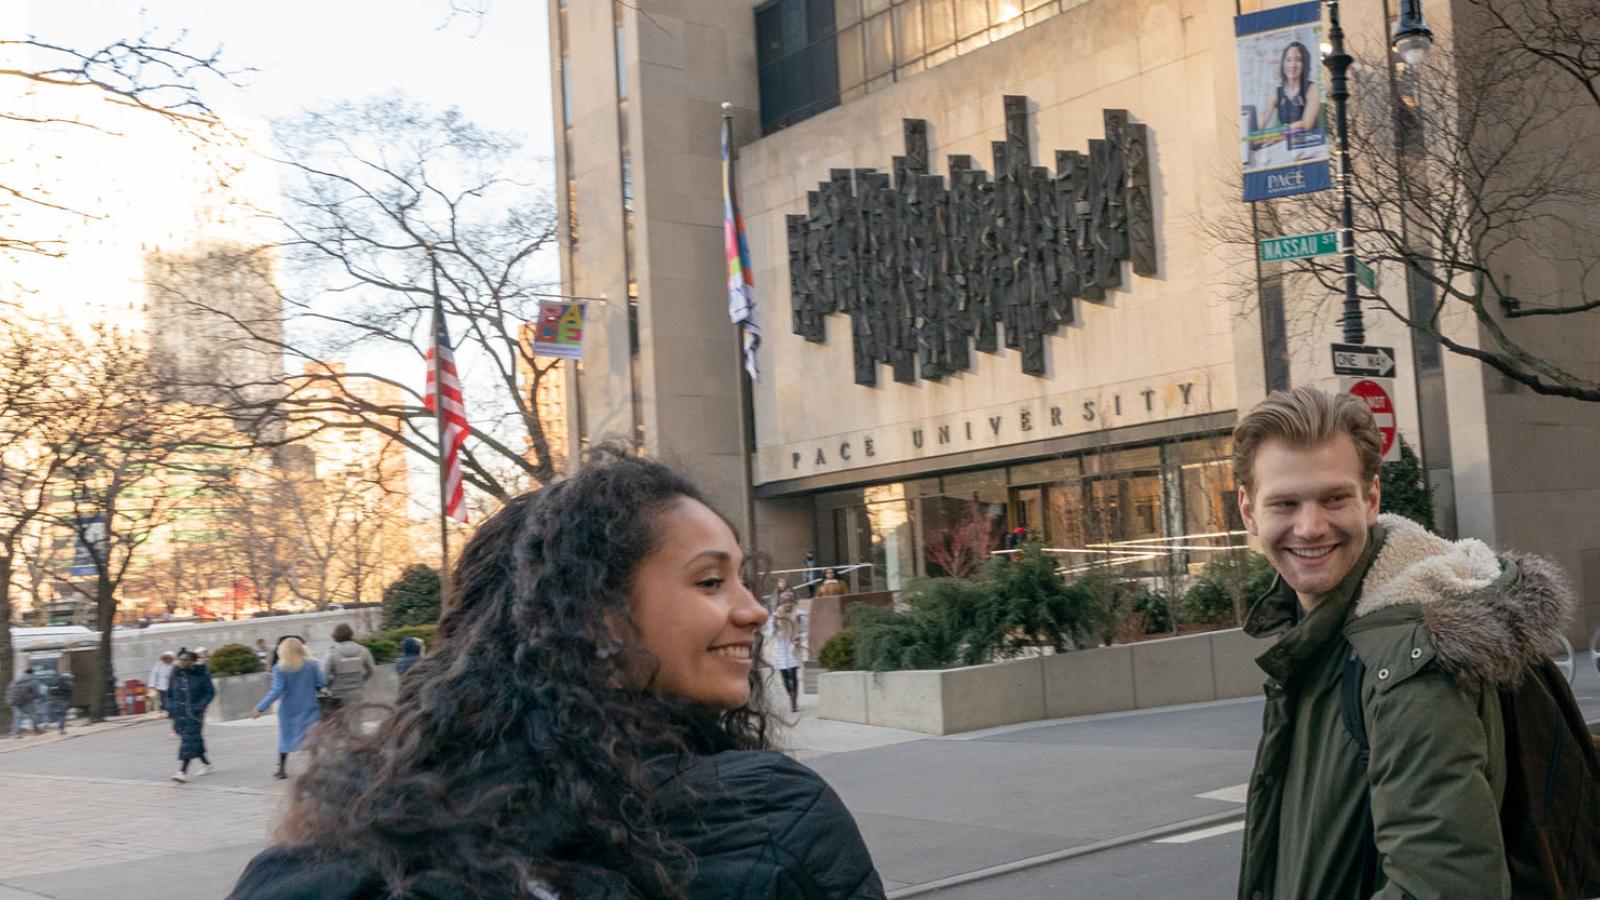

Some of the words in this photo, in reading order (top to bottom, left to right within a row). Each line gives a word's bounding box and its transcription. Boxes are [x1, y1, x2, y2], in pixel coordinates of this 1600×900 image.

[1267, 171, 1306, 188] PACE
[1263, 236, 1317, 260] NASSAU
[791, 437, 876, 469] PACE
[912, 382, 1193, 449] UNIVERSITY
